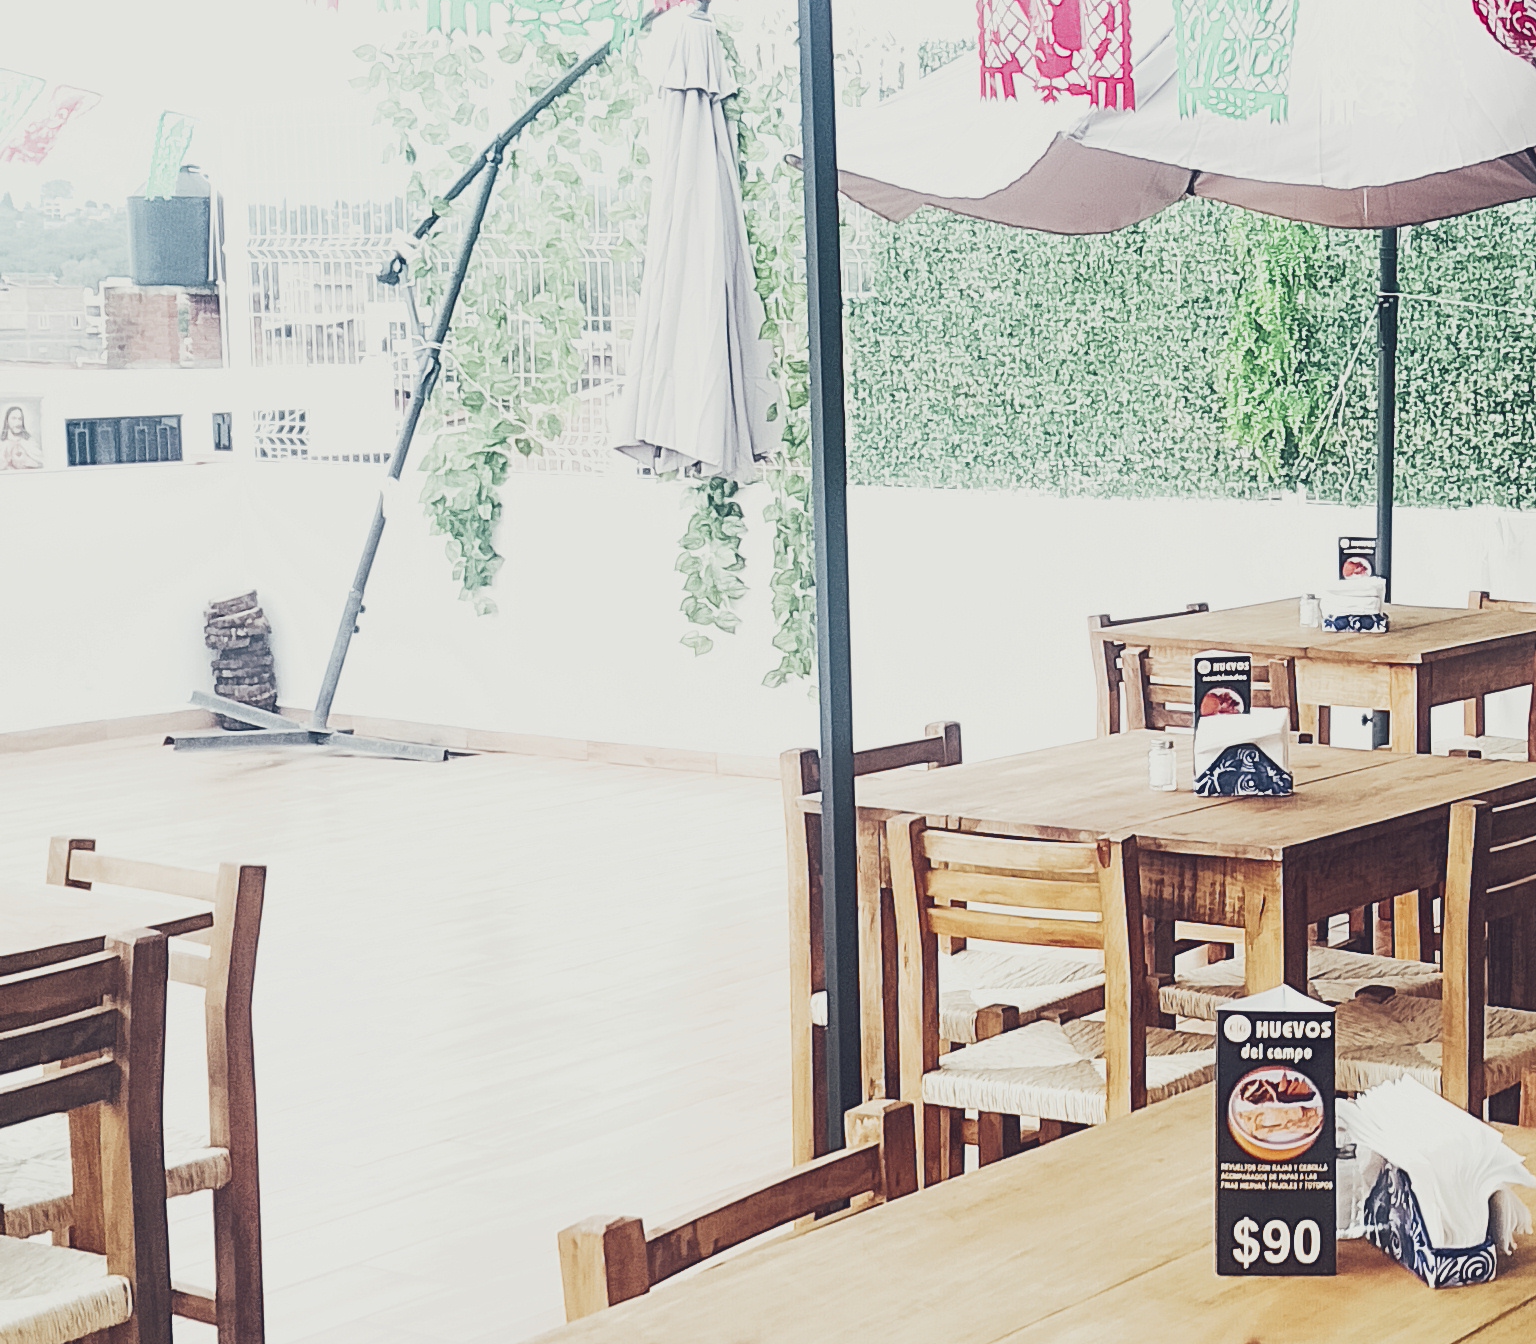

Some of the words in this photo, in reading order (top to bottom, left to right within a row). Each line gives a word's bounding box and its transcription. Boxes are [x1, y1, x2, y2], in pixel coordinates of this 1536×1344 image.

[1255, 1020, 1332, 1039] HUEVOS
[1240, 1042, 1264, 1060] del
[1266, 1047, 1313, 1064] campo
[1232, 1217, 1321, 1269] $90
